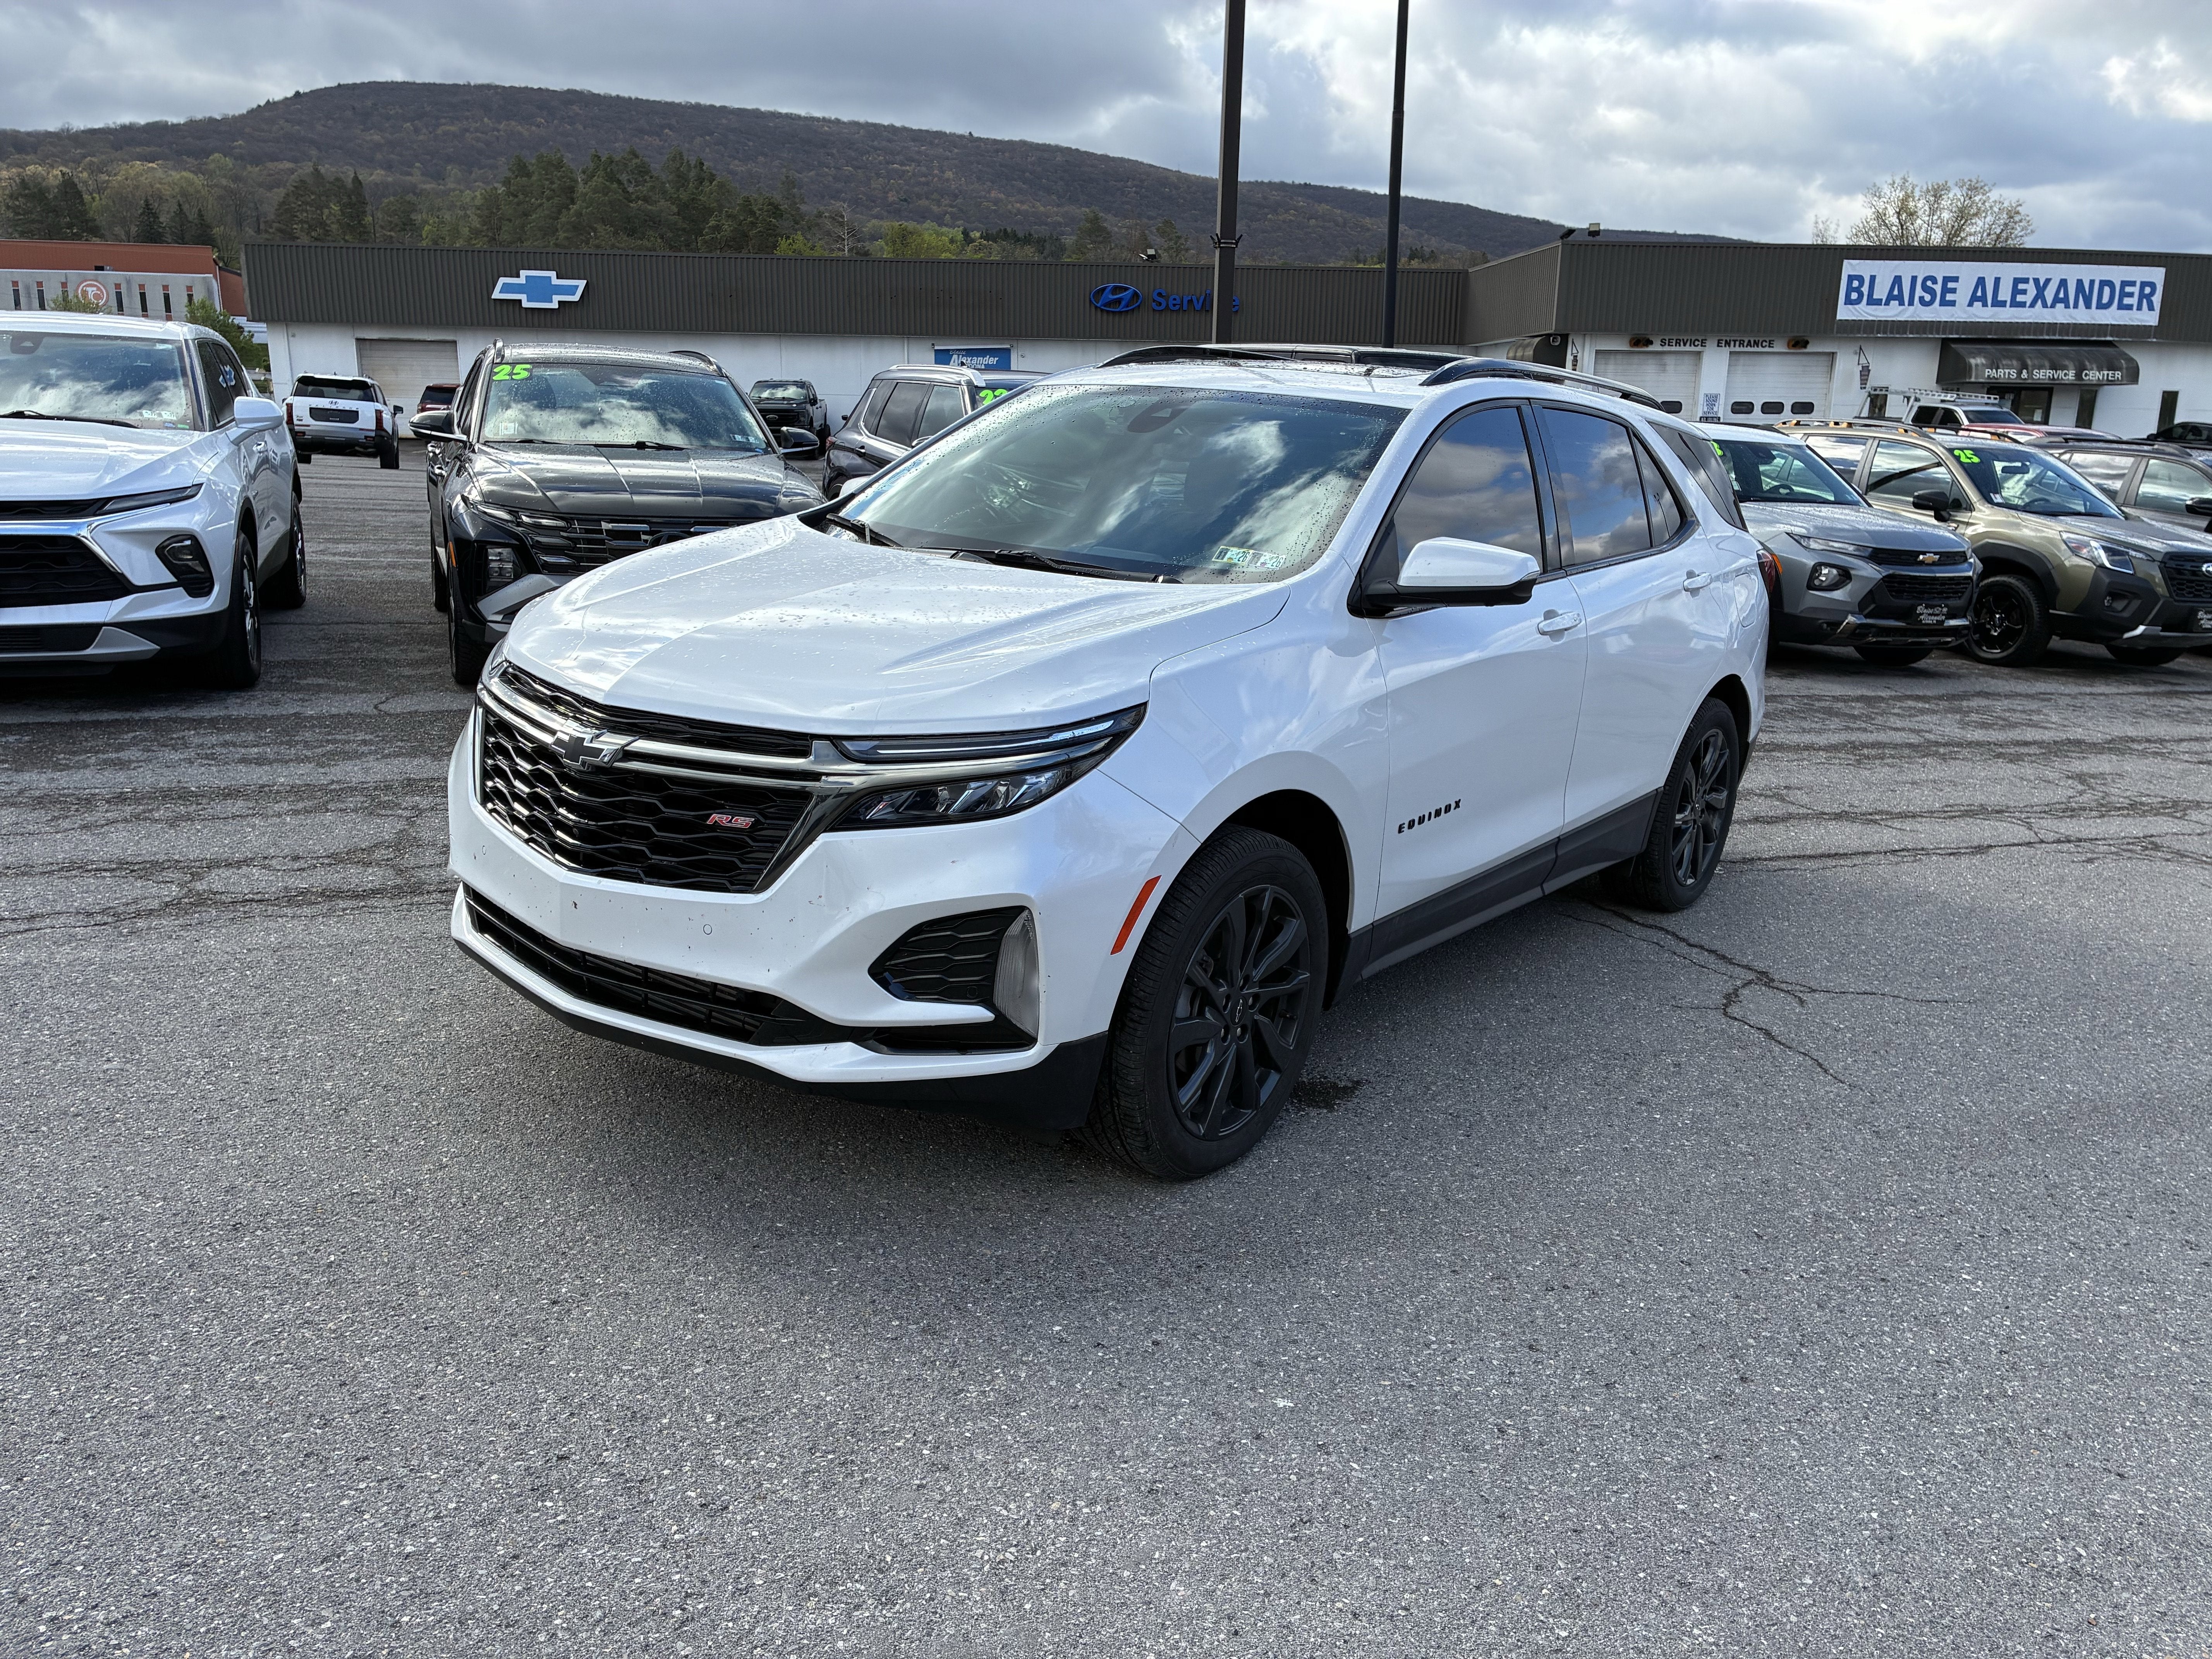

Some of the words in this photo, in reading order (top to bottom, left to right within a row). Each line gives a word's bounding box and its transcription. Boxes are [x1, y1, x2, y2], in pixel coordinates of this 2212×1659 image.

[1844, 274, 1959, 307] BLAISE
[1967, 276, 2157, 311] ALEXANDER
[1152, 288, 1240, 312] Servie
[1659, 338, 1707, 347] SERVICE
[1716, 339, 1775, 348] ENTRANCE
[950, 354, 999, 367] Alexander
[492, 364, 532, 381] 25
[1985, 369, 2017, 379] PARTS
[2021, 369, 2028, 379] &
[2032, 369, 2076, 380] SERVICE
[2082, 370, 2122, 381] CENTER
[1953, 449, 1981, 463] 25
[1237, 550, 1250, 563] 26
[707, 814, 755, 828] RS
[1398, 799, 1462, 834] EQUINOX
